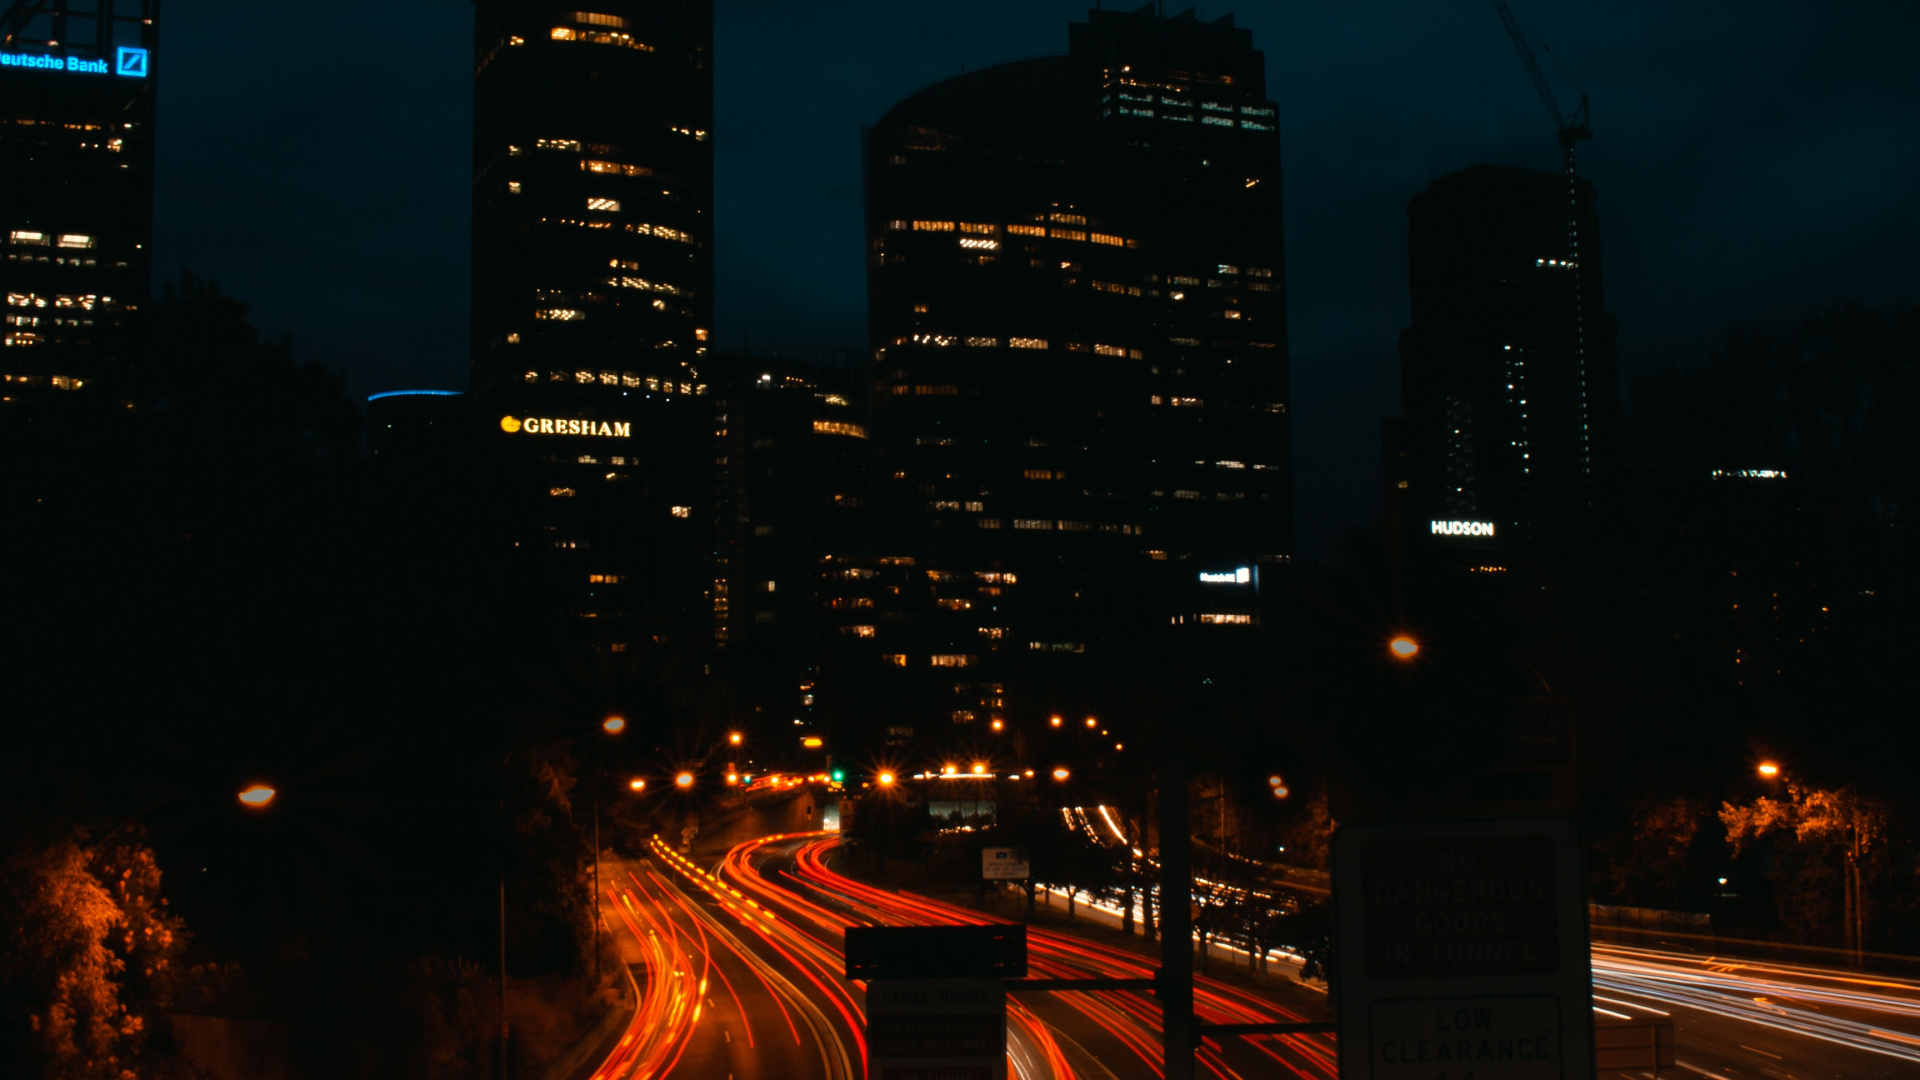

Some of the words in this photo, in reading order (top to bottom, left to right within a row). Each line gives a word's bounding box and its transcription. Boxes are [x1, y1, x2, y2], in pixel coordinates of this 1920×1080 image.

[0, 52, 64, 69] eutsche
[67, 56, 108, 73] Bank
[523, 417, 631, 437] GRESHAM
[1431, 520, 1495, 536] HUDSON
[1439, 849, 1476, 872] NO
[1374, 877, 1544, 905] DANGEROUS
[1415, 911, 1506, 936] GOODS
[1386, 944, 1411, 966] IN
[1430, 940, 1537, 965] TUNNEL
[881, 989, 930, 1005] CAHILL
[939, 988, 991, 1004] TUNNEL
[1436, 1008, 1492, 1032] LOW
[1381, 1037, 1550, 1064] CLEARANCE
